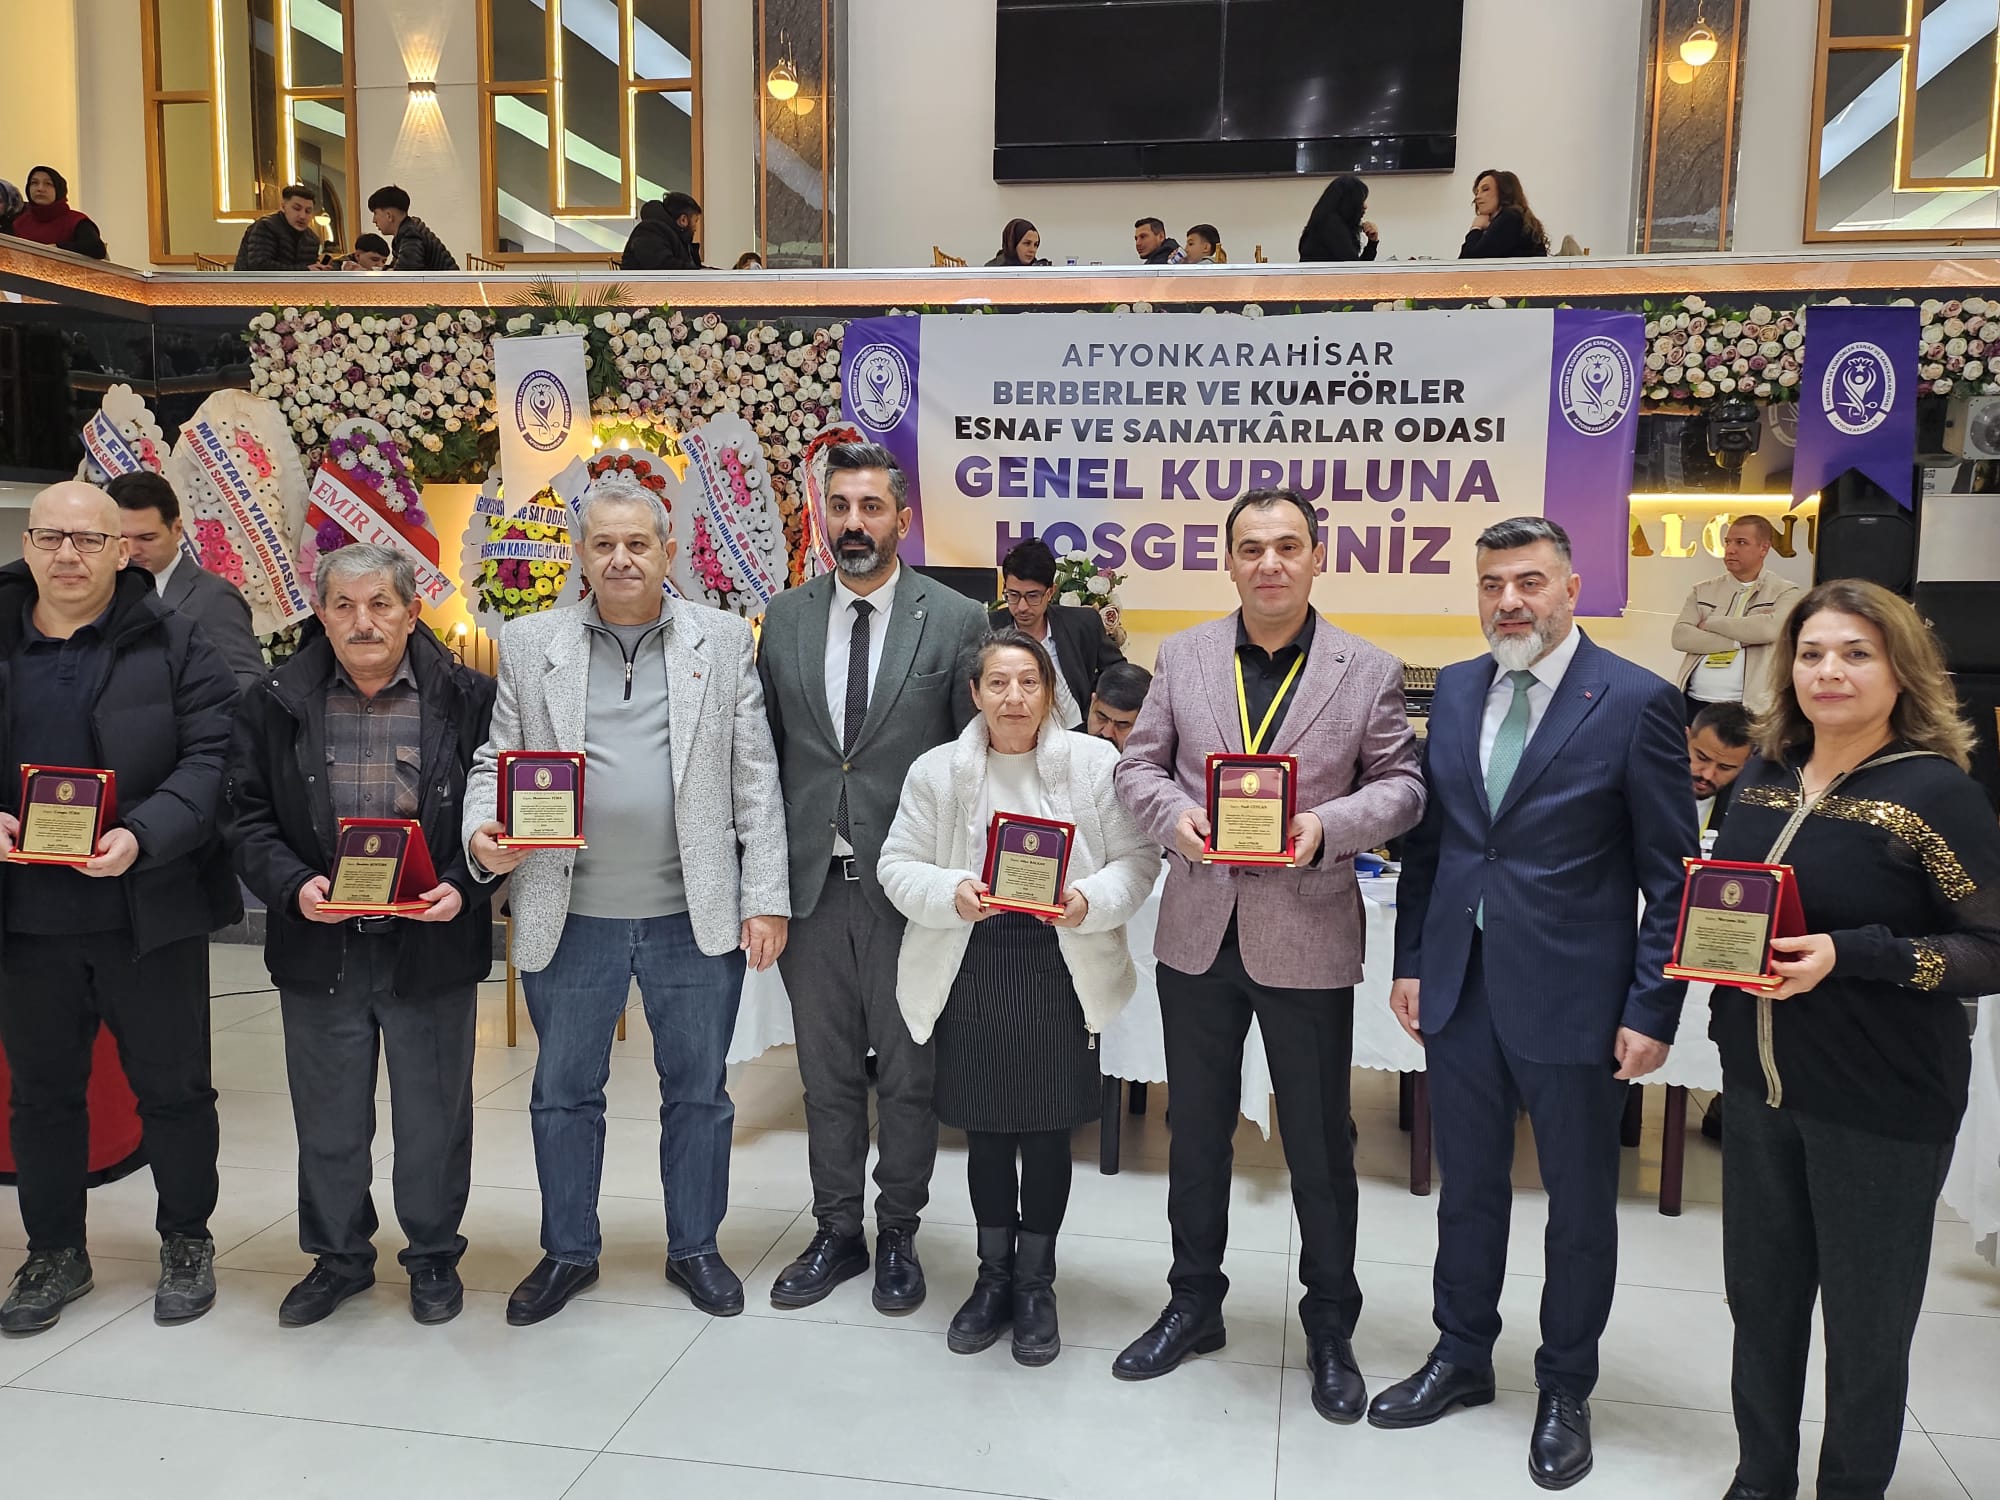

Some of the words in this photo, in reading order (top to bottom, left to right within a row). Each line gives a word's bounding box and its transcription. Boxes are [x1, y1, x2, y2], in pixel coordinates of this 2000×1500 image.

[1062, 335, 1394, 367] AFYONKARAHİSAR
[993, 381, 1187, 405] BERBERLER
[1197, 381, 1241, 405] VE
[1250, 370, 1465, 405] KUAFÖRLER
[954, 416, 1063, 442] ESNAF
[1071, 418, 1114, 443] VE
[1123, 410, 1384, 444] SANATKÂRLAR
[1395, 417, 1505, 443] ODASI
[693, 434, 736, 527] CENGİZ
[955, 455, 1144, 500] GENEL
[1161, 459, 1501, 502] KURULUNA
[184, 428, 217, 470] MADENİ
[211, 470, 261, 545] SANATKARLAR
[255, 543, 278, 577] ODASI
[271, 575, 295, 618] BAŞKANI
[196, 421, 253, 501] MUSTAFA
[249, 502, 307, 612] YILMAZASLAN
[313, 480, 370, 533] EMİR
[718, 522, 743, 563] ODALARI
[738, 559, 764, 592] BİRLİĞİ
